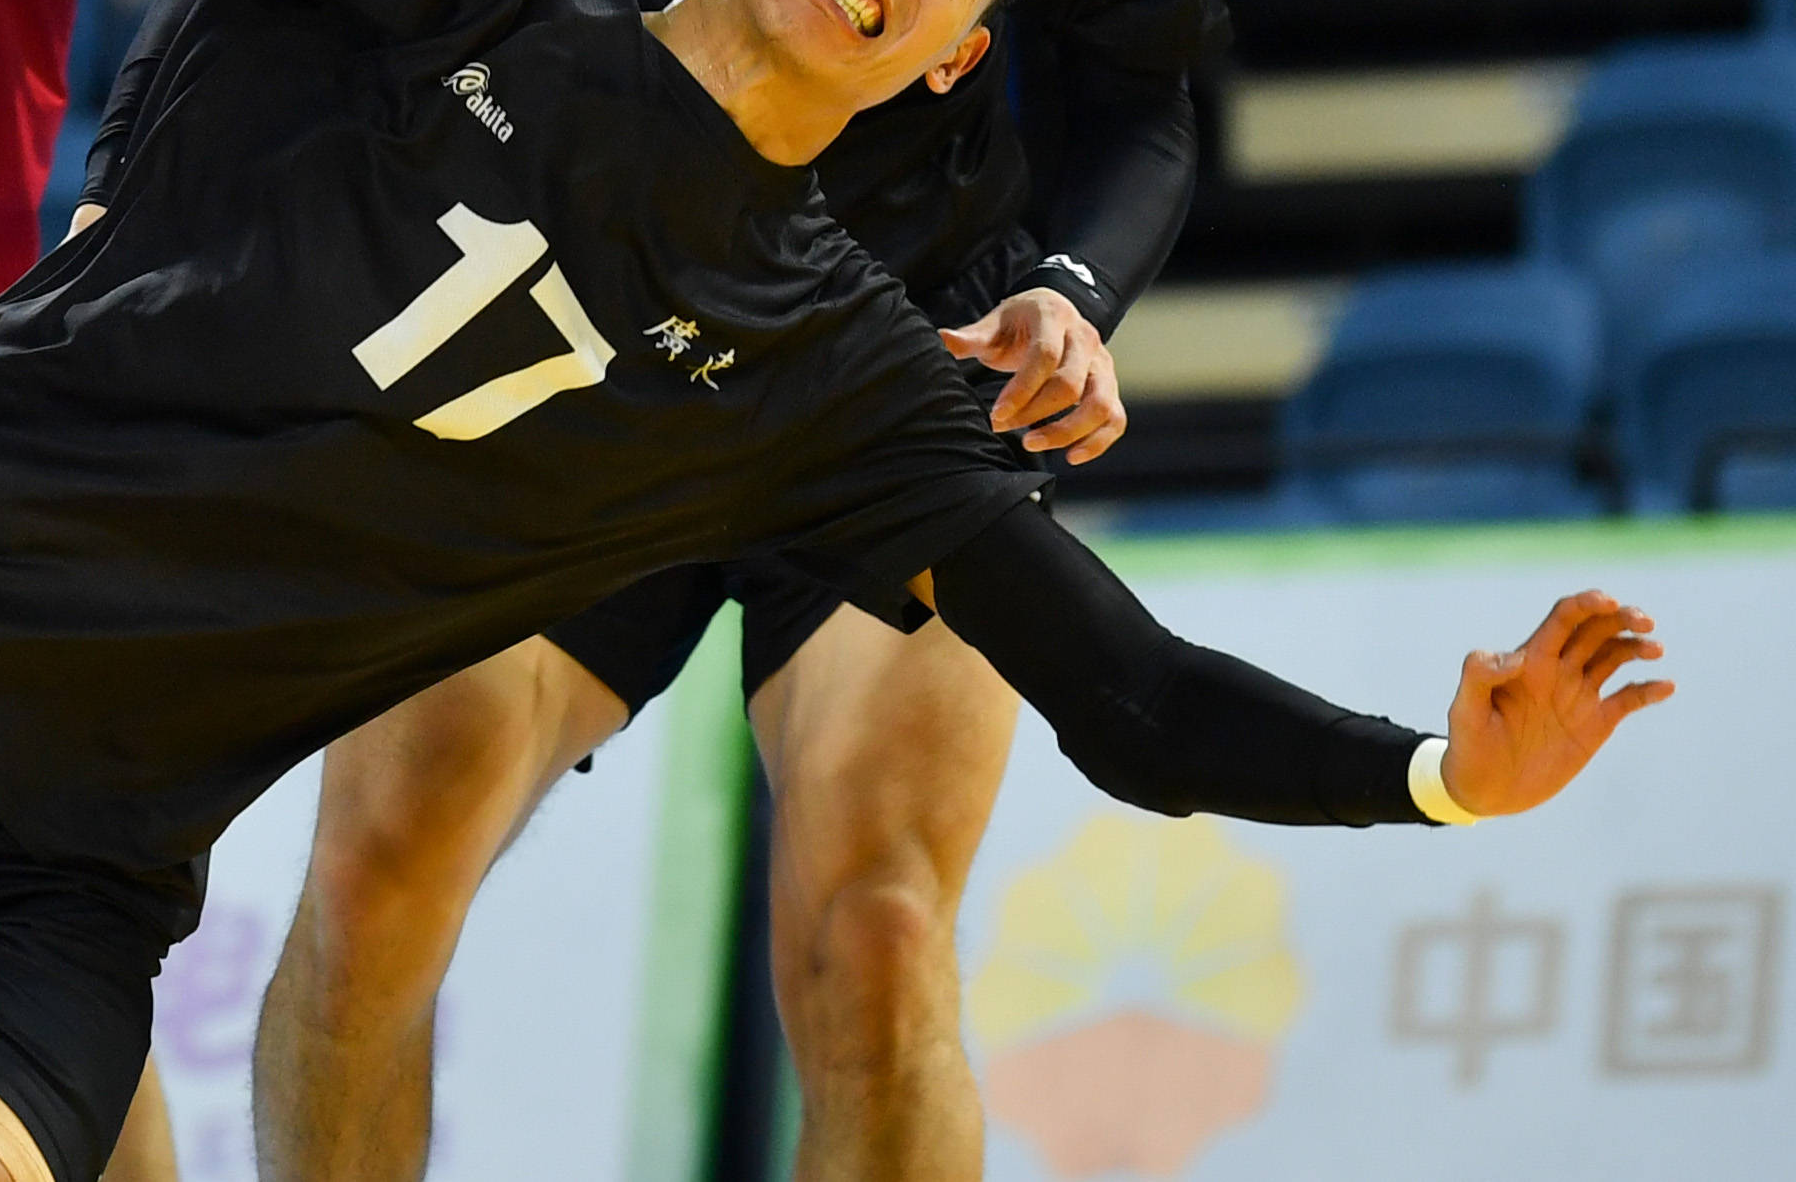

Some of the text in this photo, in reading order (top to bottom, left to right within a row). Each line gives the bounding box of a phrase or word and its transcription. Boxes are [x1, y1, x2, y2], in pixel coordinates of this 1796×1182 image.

[465, 89, 515, 143] akita
[351, 201, 617, 442] 17
[1387, 882, 1785, 1092] 中国
